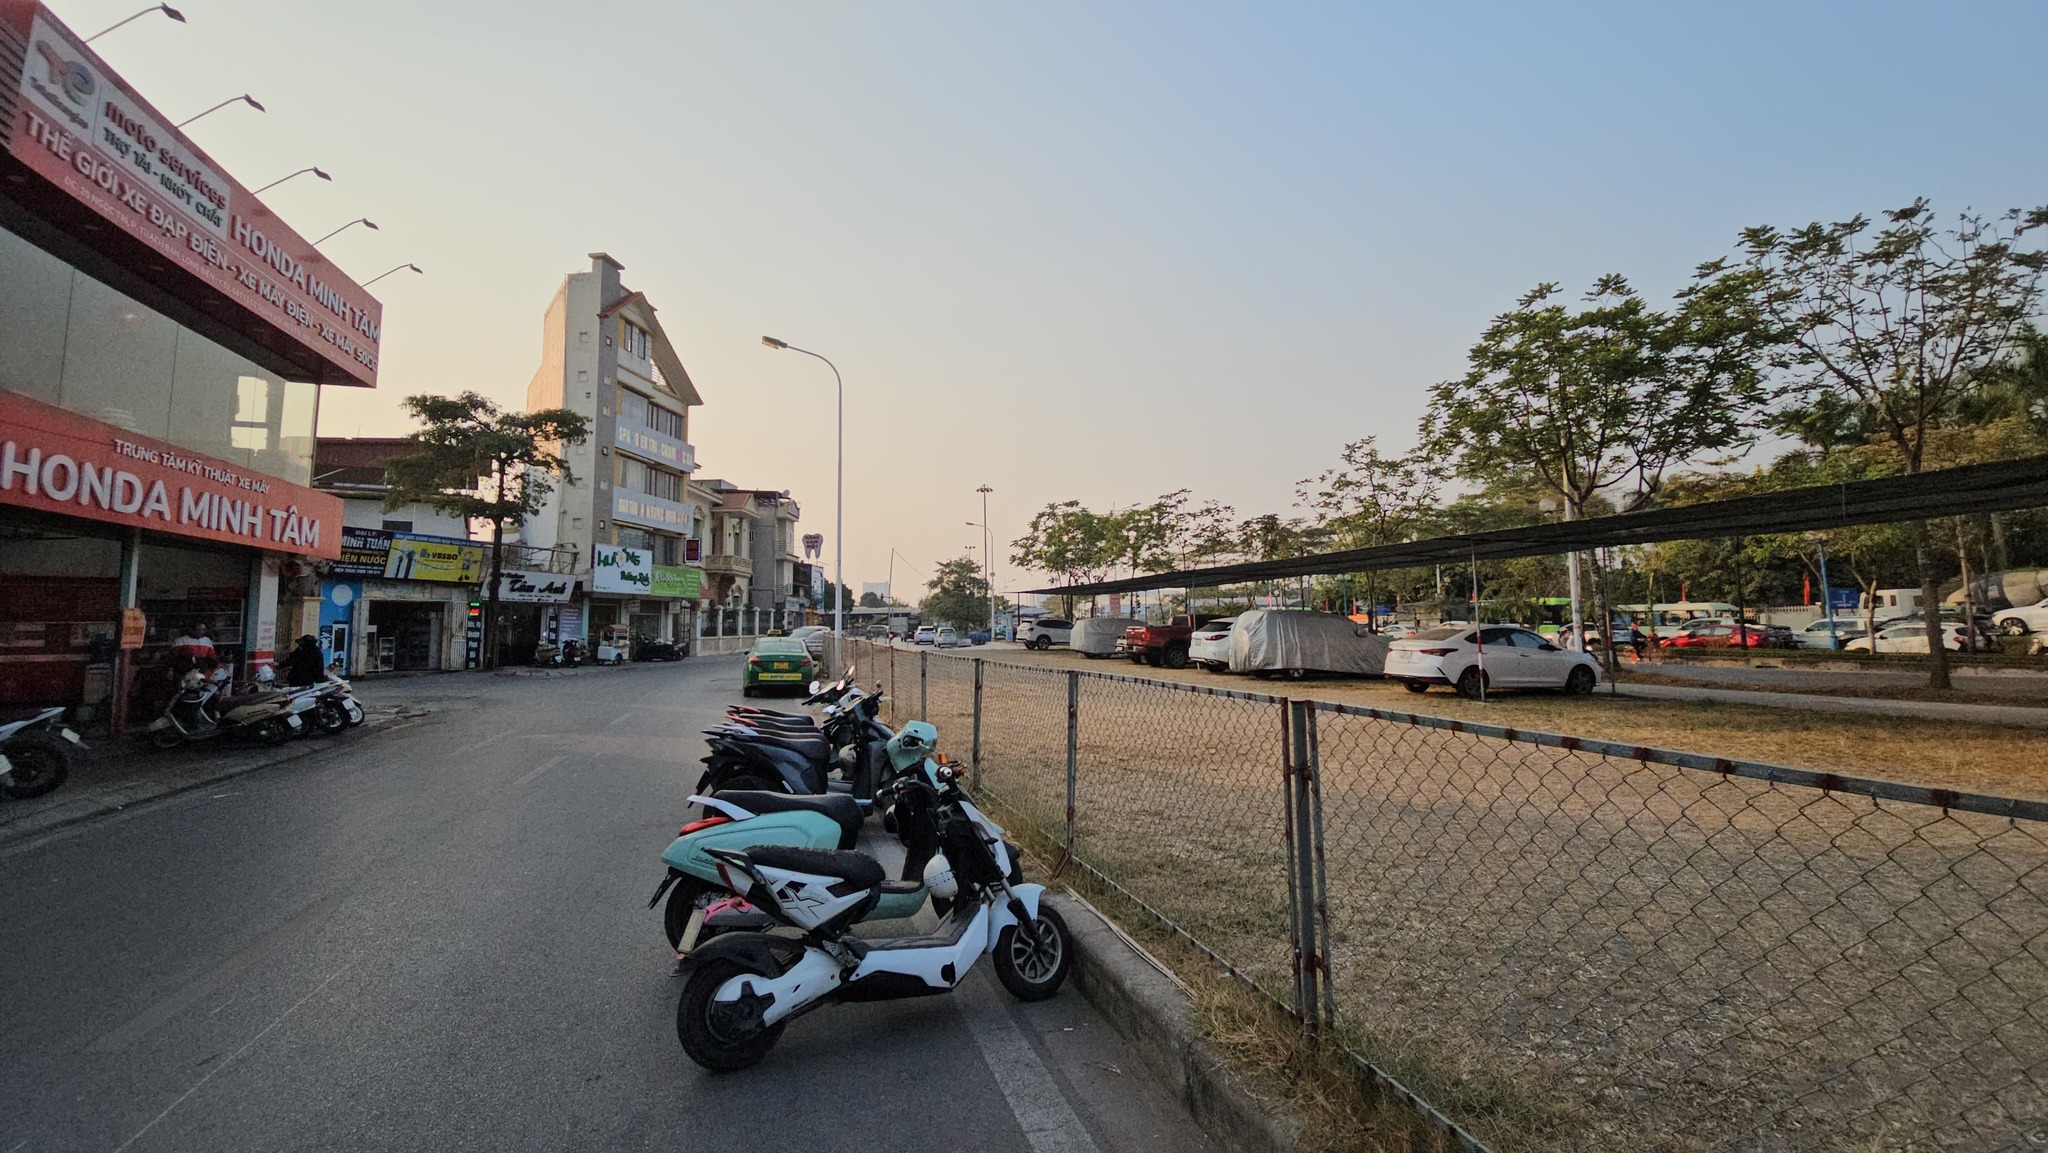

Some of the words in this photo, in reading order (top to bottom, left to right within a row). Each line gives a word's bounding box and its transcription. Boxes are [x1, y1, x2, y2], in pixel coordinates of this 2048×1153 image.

[105, 101, 157, 153] moto
[160, 146, 227, 210] services
[26, 110, 76, 161] THẾ
[75, 151, 119, 195] GIỚI
[121, 183, 147, 216] XE
[148, 202, 187, 239] ĐẠP
[189, 232, 228, 271] ĐIỆN
[236, 265, 257, 290] XE
[257, 279, 286, 308] MÁY
[286, 299, 313, 328] ĐIỆN
[320, 322, 336, 342] XE
[336, 335, 355, 356] MÁY
[232, 214, 305, 290] HONDA
[307, 275, 350, 321] MINH
[350, 307, 381, 344] TÂM
[2, 440, 171, 521] HONDA
[180, 486, 263, 538] MINH
[268, 504, 320, 549] TÂM
[114, 438, 158, 464] TRUNG
[162, 450, 187, 472] TÂM
[187, 456, 202, 475] KỸ
[204, 465, 237, 488] THUẬT
[237, 475, 251, 490] XE
[251, 478, 271, 494] MÁY
[362, 552, 387, 565] NƯỚC
[366, 536, 391, 550] TUẤN
